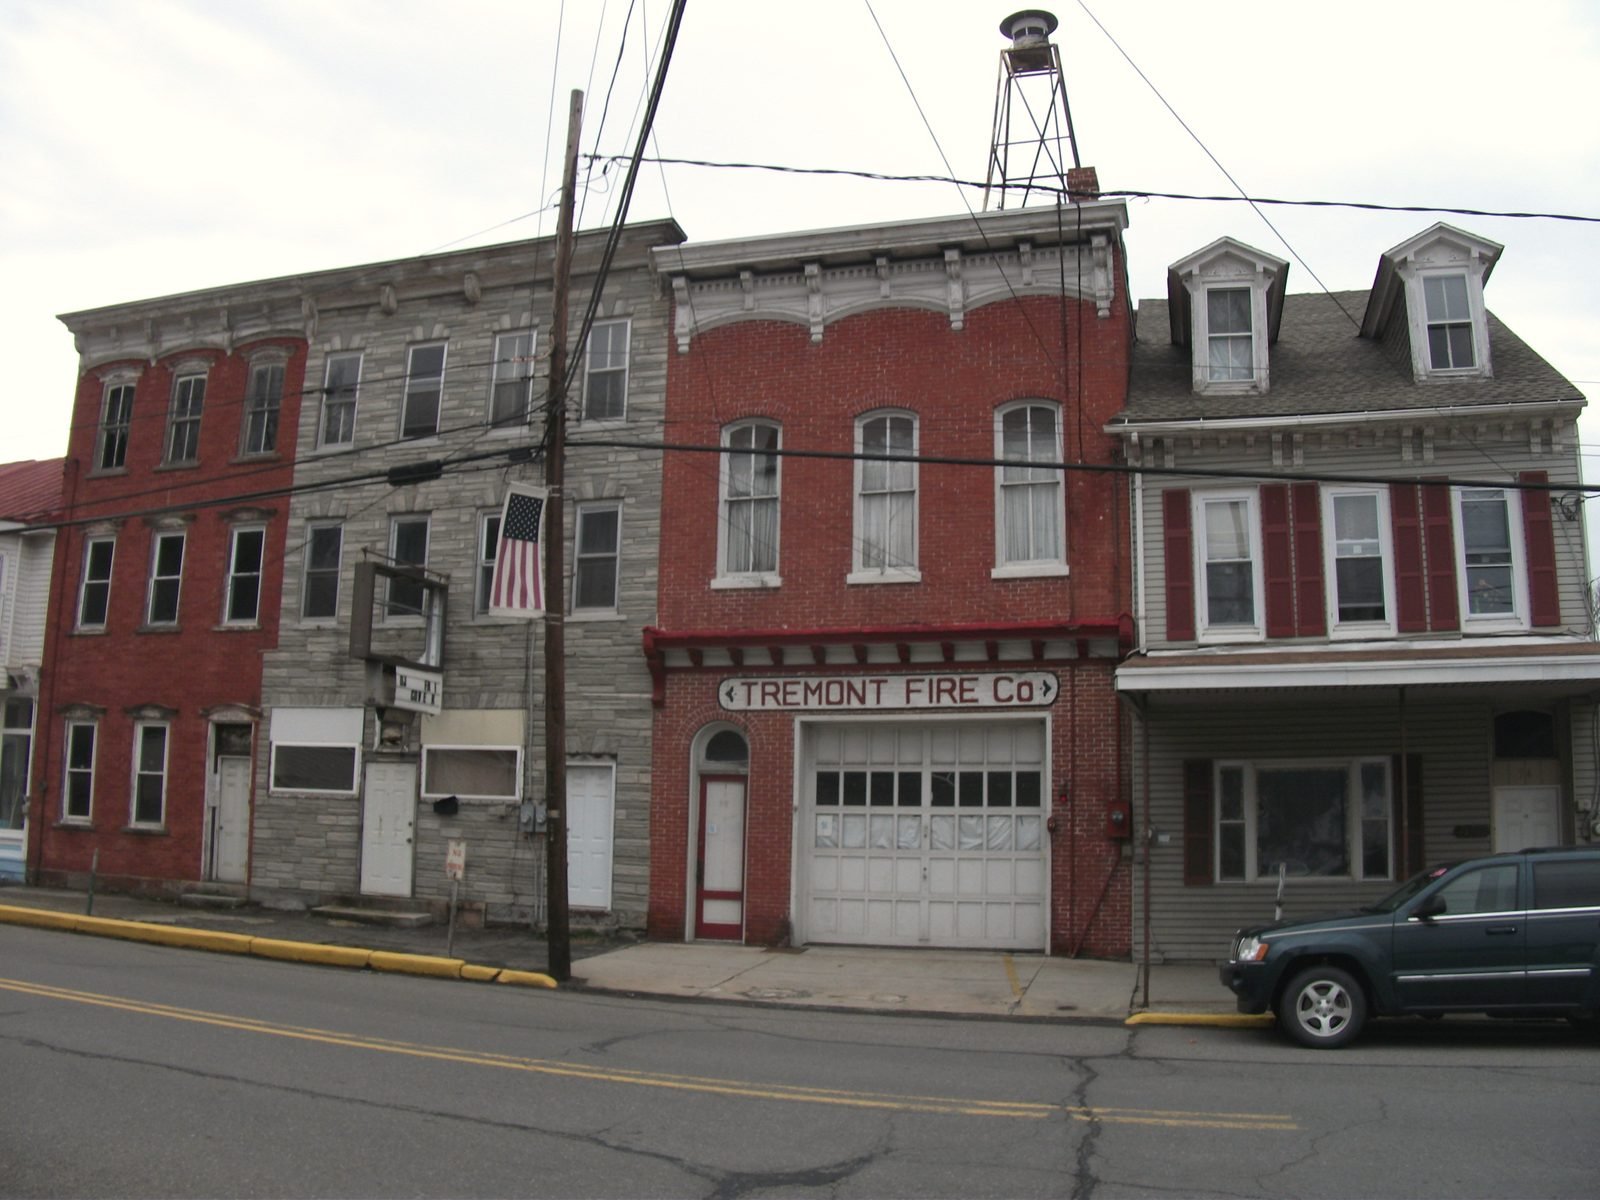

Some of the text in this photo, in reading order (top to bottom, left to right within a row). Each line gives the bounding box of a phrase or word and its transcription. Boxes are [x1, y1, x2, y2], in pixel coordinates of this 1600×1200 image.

[740, 676, 1034, 706] TREMONT FIRE Co
